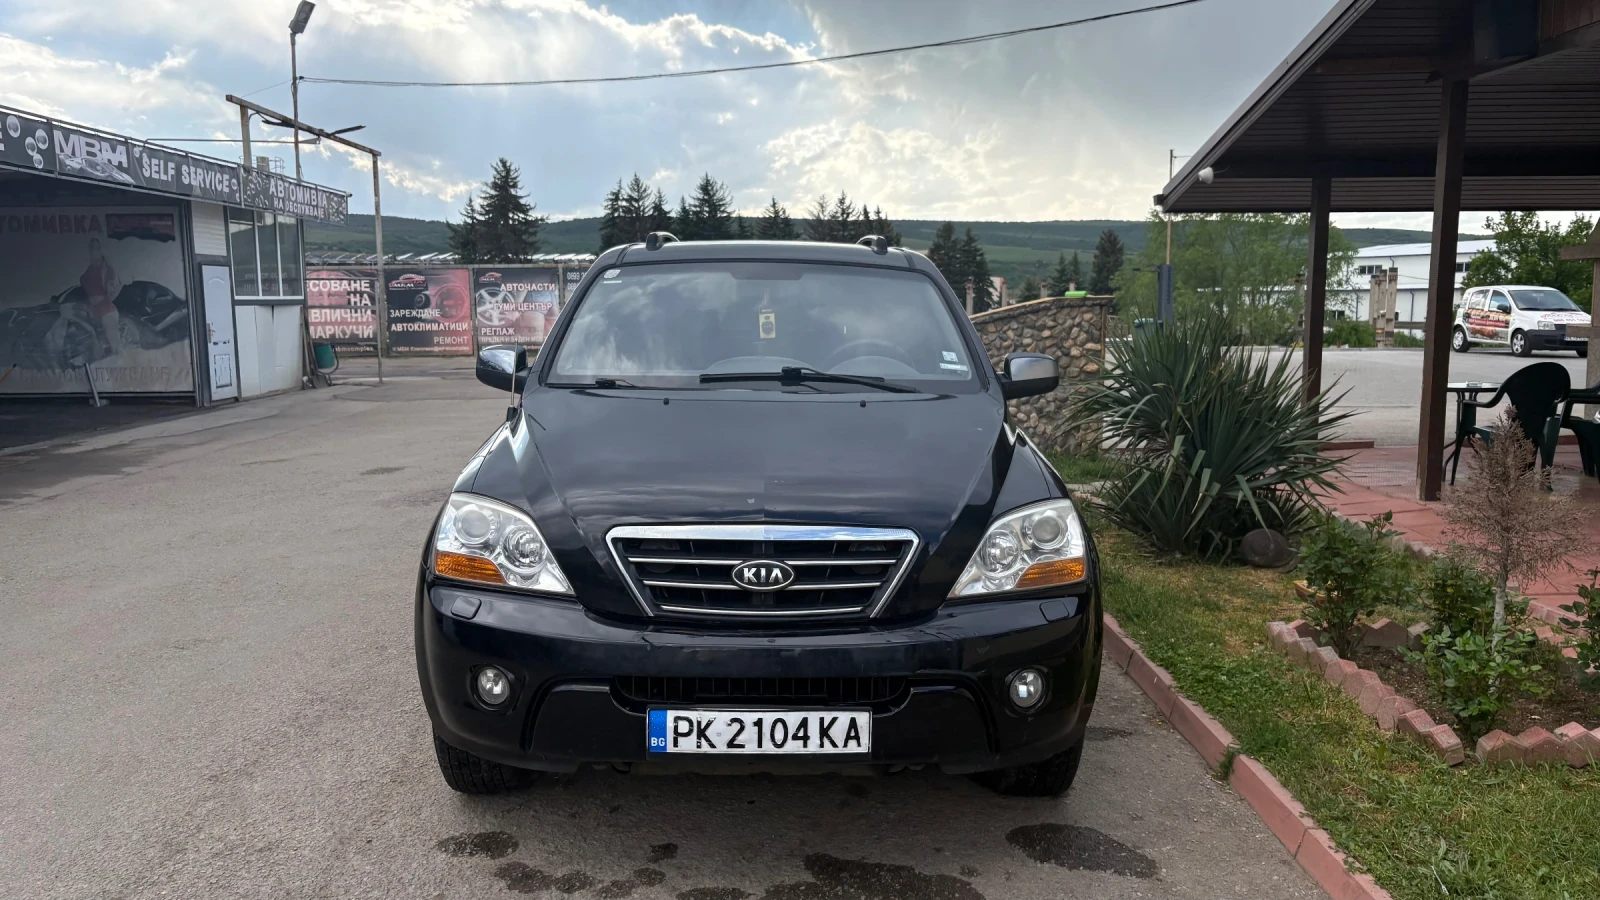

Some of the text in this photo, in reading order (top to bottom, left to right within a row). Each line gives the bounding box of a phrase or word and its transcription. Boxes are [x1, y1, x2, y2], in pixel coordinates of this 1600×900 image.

[142, 152, 230, 193] SELF SERVICE
[269, 178, 327, 208] АВТОМИВКА
[273, 197, 284, 210] НА
[500, 283, 556, 292] АВТОЧАСТИ
[350, 293, 372, 306] НА
[389, 309, 440, 318] ЗАРЕЖДАНЕ
[494, 303, 552, 311] ГУМИ ЦЕНТЪР
[308, 308, 372, 322] ВЛИЧНИ
[391, 323, 468, 332] АВТОКЛИМАТИЦИ
[481, 327, 515, 336] РЕГЛАЖ
[434, 336, 469, 344] РЕМОНТ
[743, 567, 784, 583] KIA
[651, 716, 862, 749] BG PK 2104 KA
